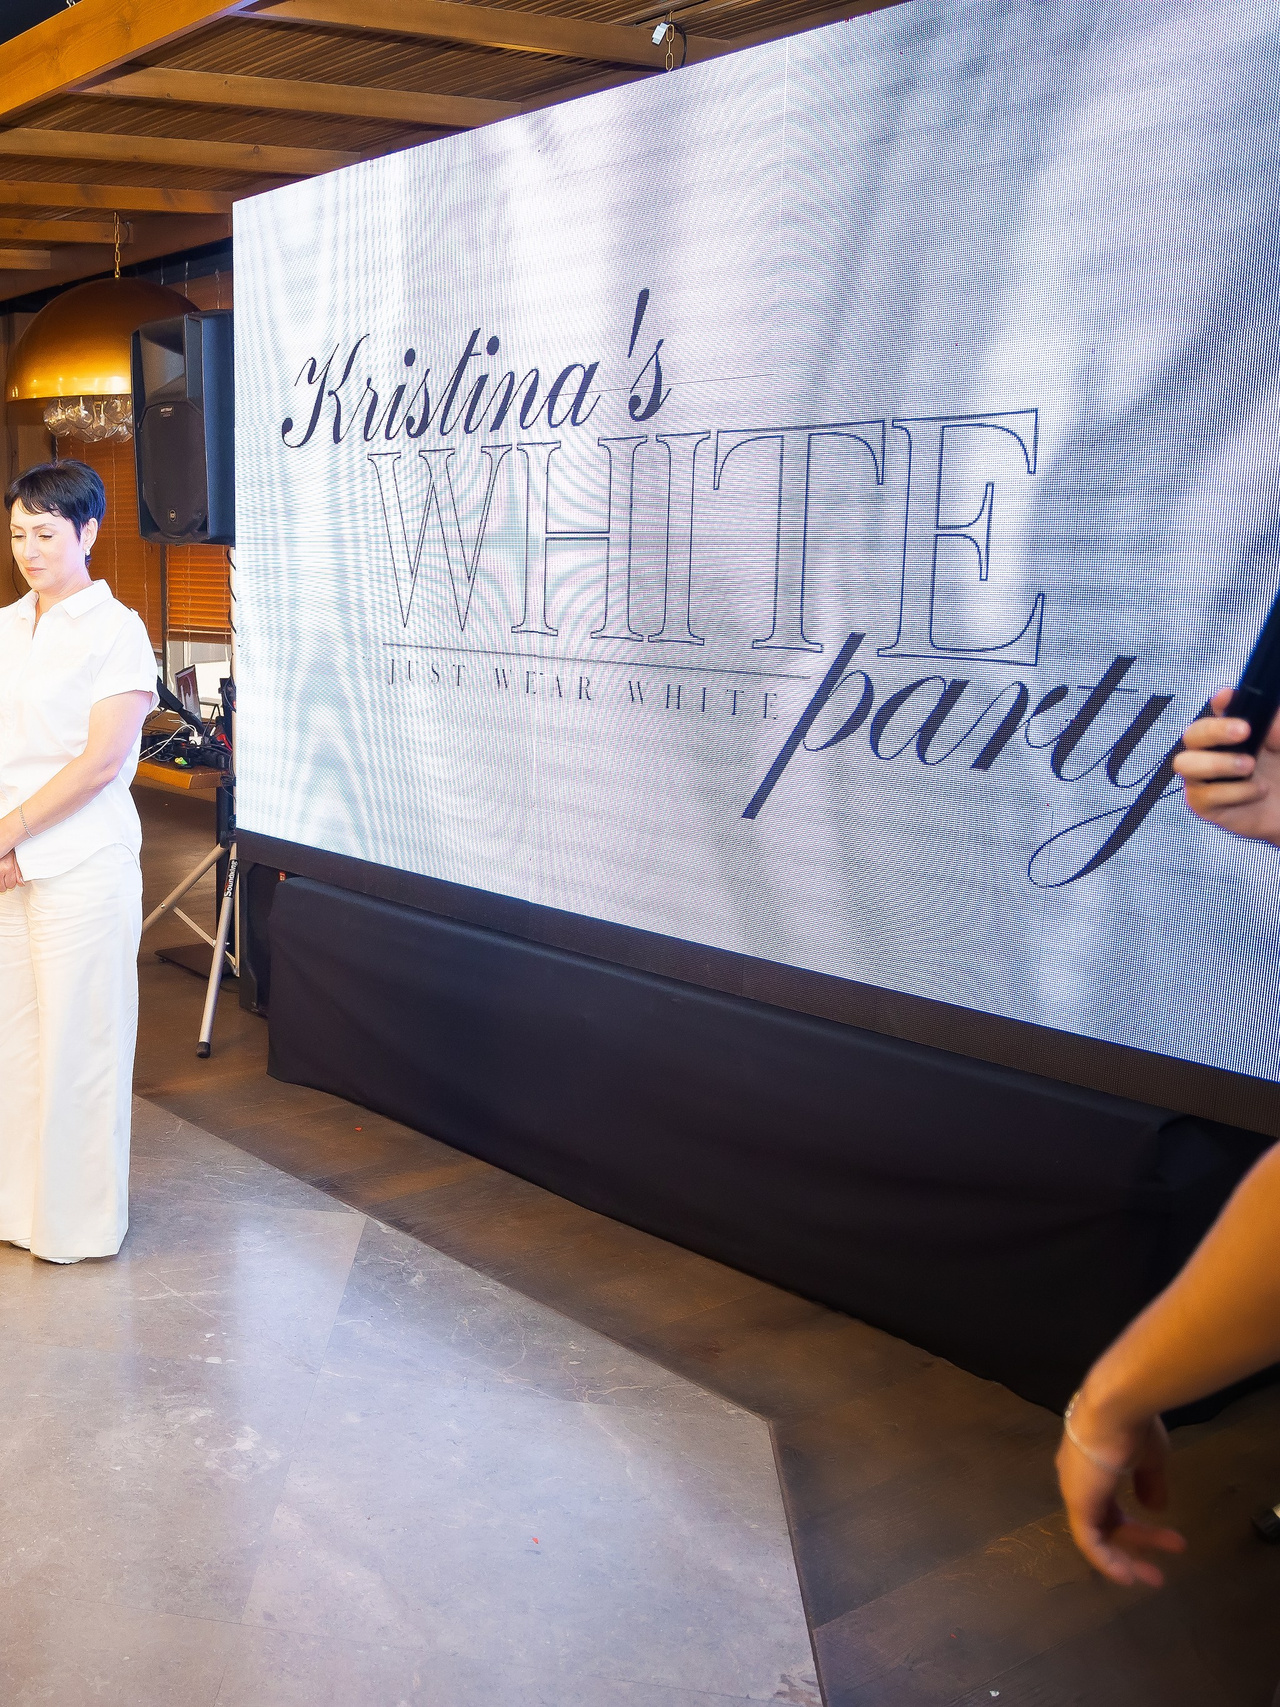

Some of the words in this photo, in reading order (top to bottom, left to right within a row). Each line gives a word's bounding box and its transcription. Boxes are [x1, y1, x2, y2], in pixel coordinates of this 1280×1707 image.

[281, 288, 672, 448] Kristina's
[367, 408, 1045, 666] WHITE
[387, 658, 466, 687] JUST
[494, 667, 592, 701] WEAR
[628, 680, 778, 720] WHITE
[741, 632, 1212, 888] party
[224, 860, 238, 897] Soundking
